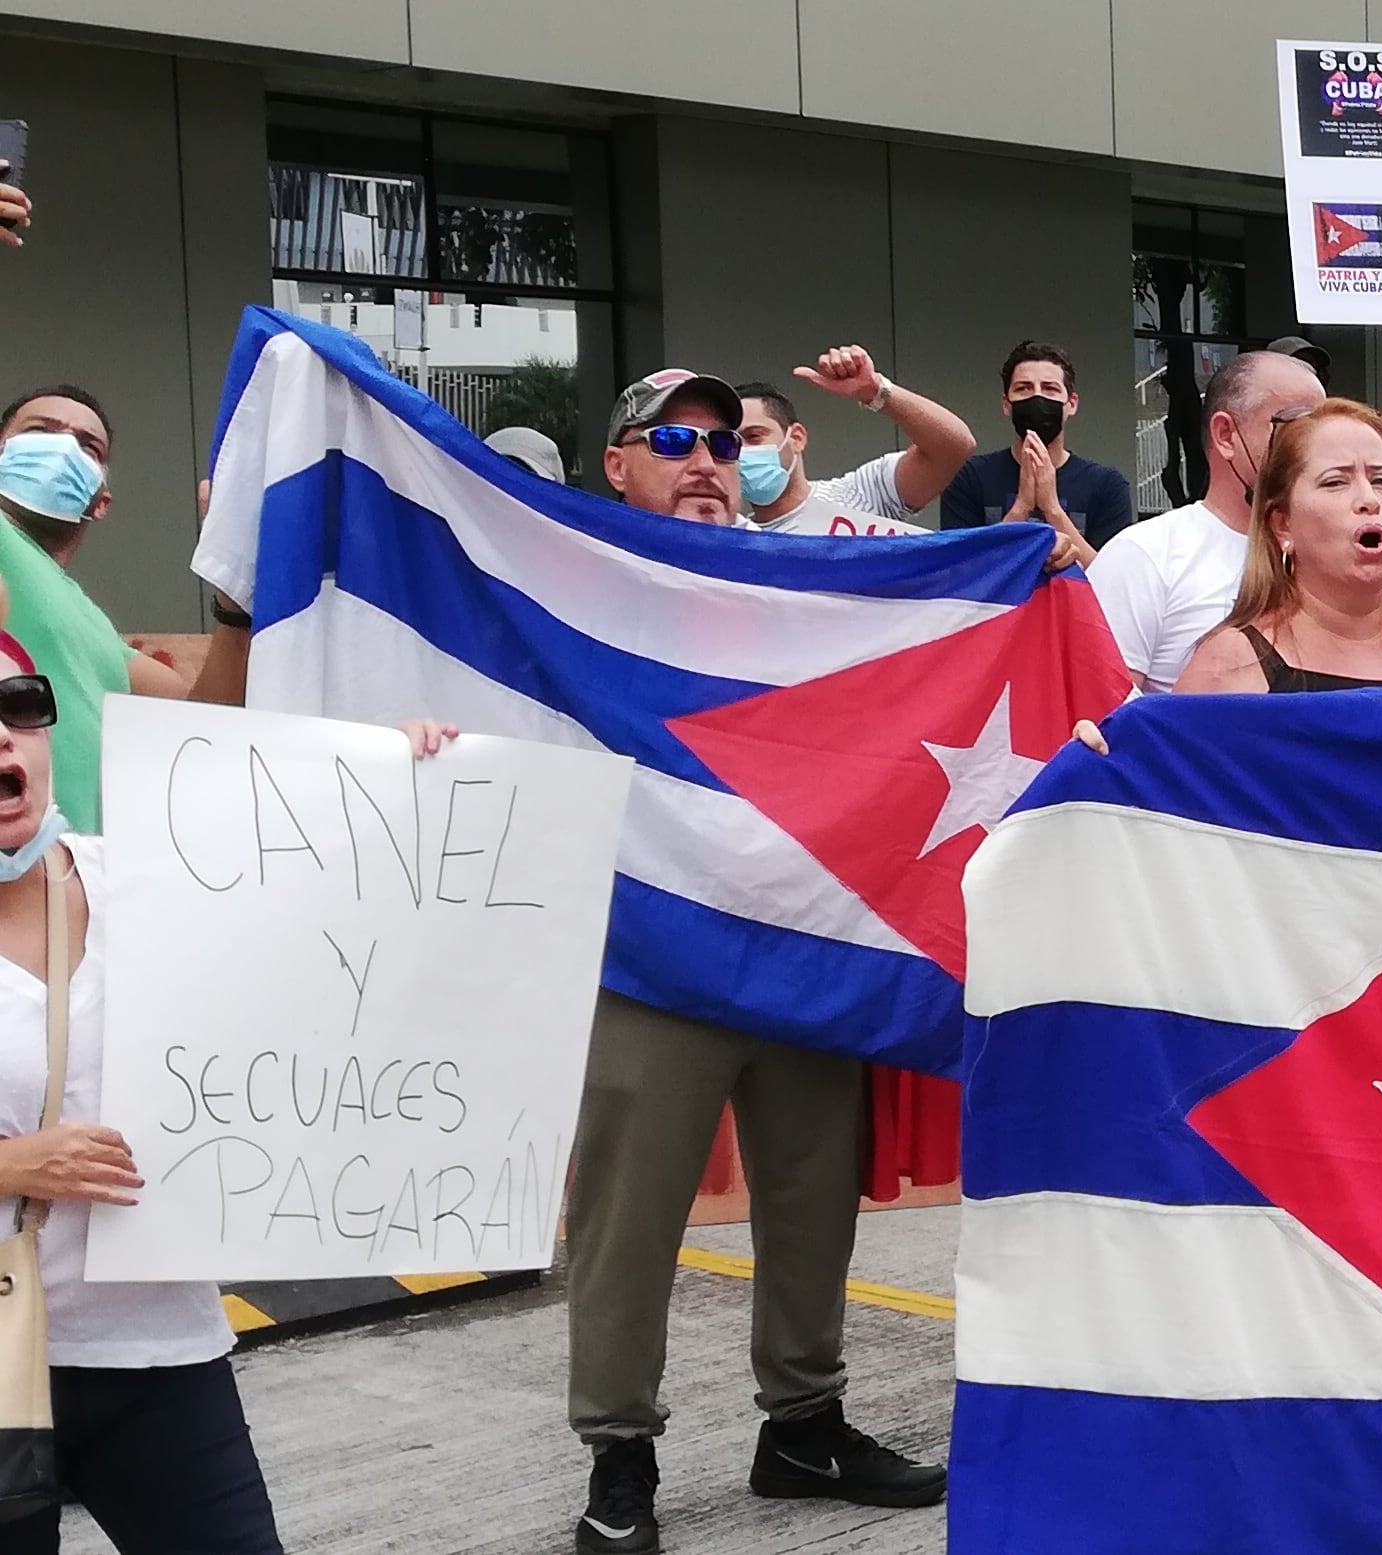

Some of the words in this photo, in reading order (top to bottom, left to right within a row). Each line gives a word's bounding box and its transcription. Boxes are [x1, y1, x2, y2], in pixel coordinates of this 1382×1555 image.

[1318, 270, 1368, 281] PATRIA
[1371, 271, 1380, 281] Y
[1319, 281, 1350, 293] VIVA
[167, 736, 544, 910] CANEL
[322, 930, 376, 1037] Y
[160, 1045, 467, 1134] SECUACES
[160, 1107, 561, 1262] PAGARÁN
